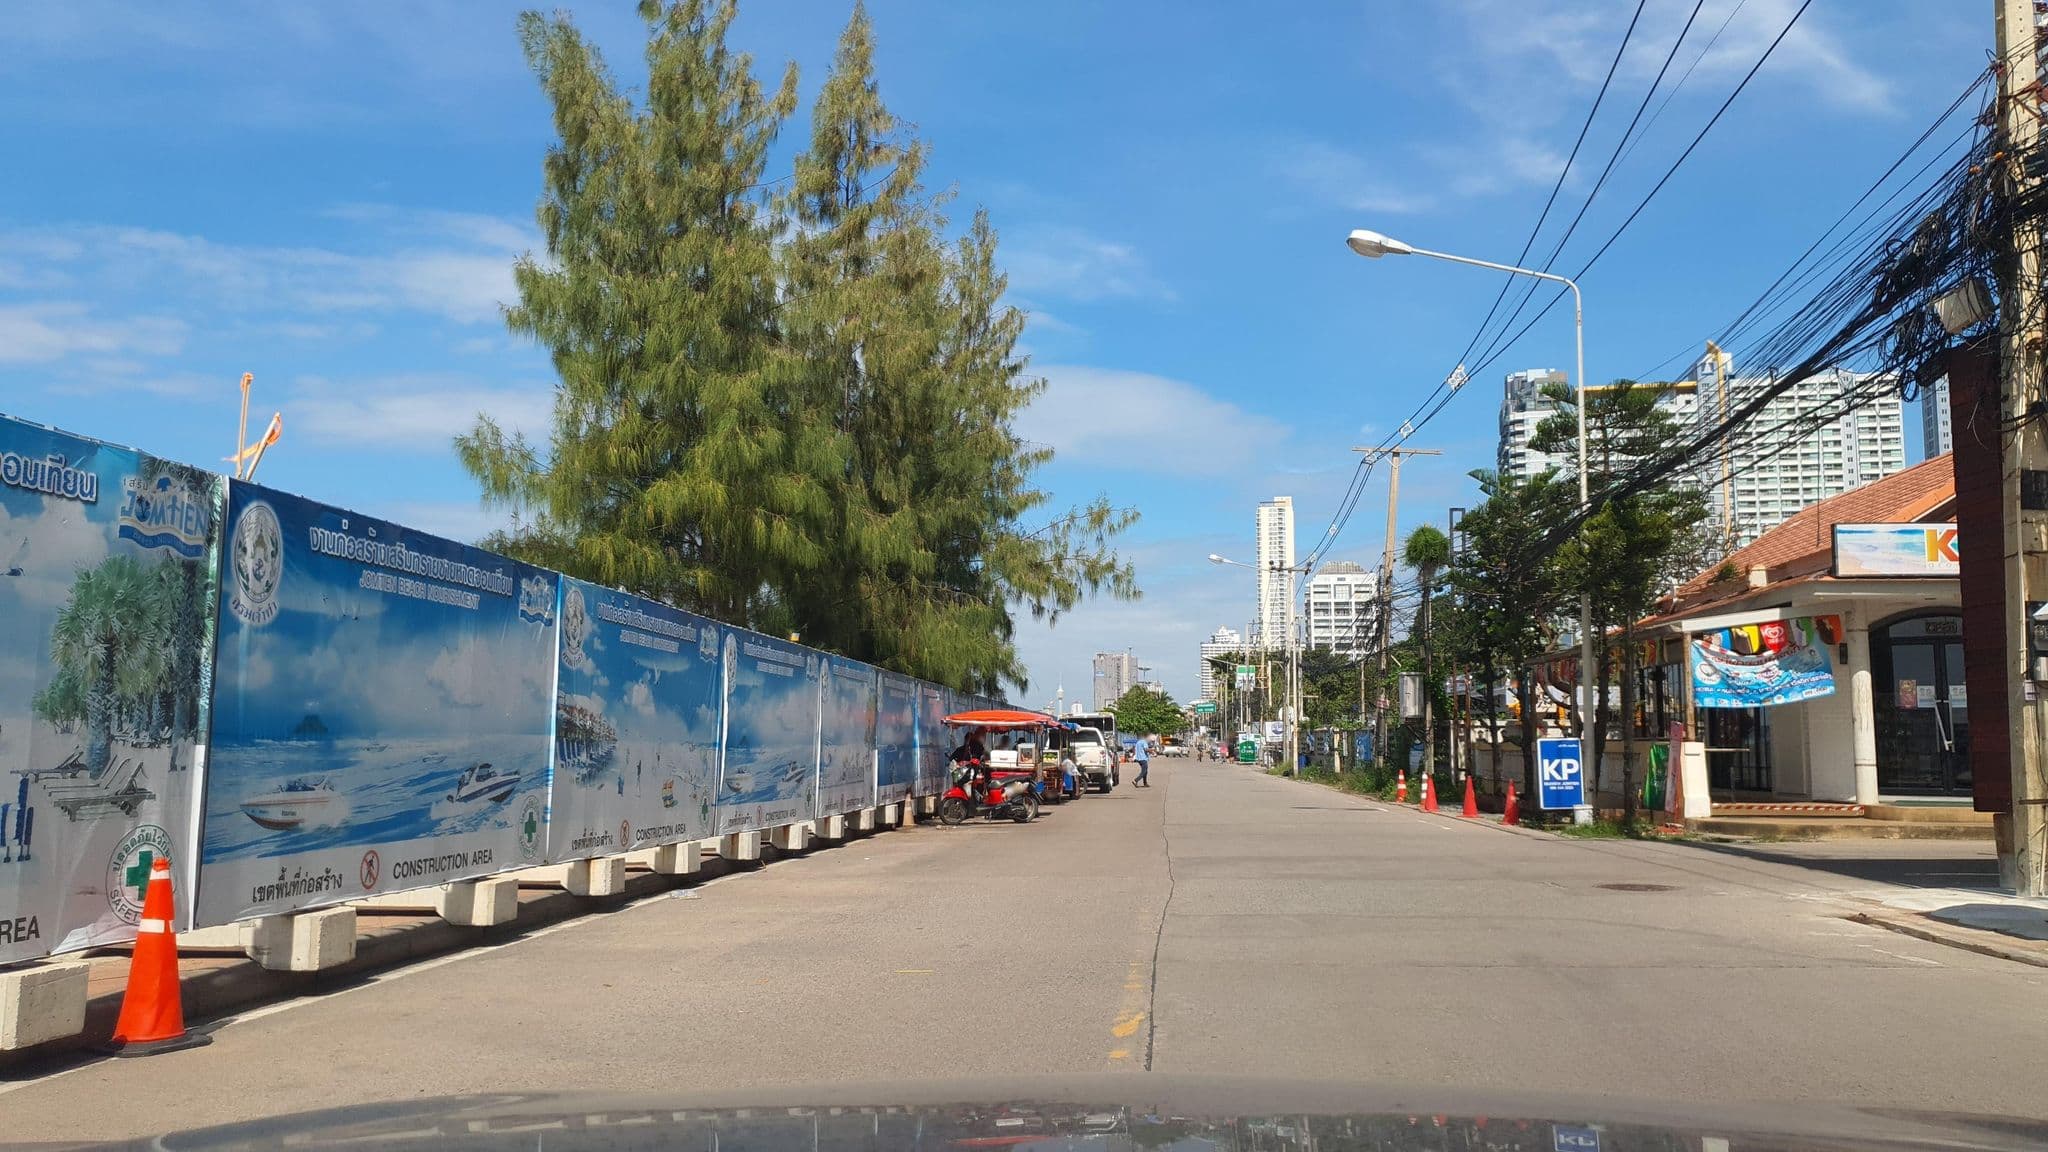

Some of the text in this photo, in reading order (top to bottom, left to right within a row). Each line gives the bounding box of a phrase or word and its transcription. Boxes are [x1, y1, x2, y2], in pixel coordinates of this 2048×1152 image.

[0, 452, 97, 502] อมเทียน
[360, 569, 480, 610] JOMTIEN BEACH NOURISHMENT
[1542, 758, 1580, 781] KP
[635, 823, 687, 842] CONSTRUCTION AREA
[392, 848, 493, 880] CONSTRUCTION AREA
[252, 866, 343, 904] เขตพื้นที่ก่อสร้าง
[110, 888, 142, 922] SAFET
